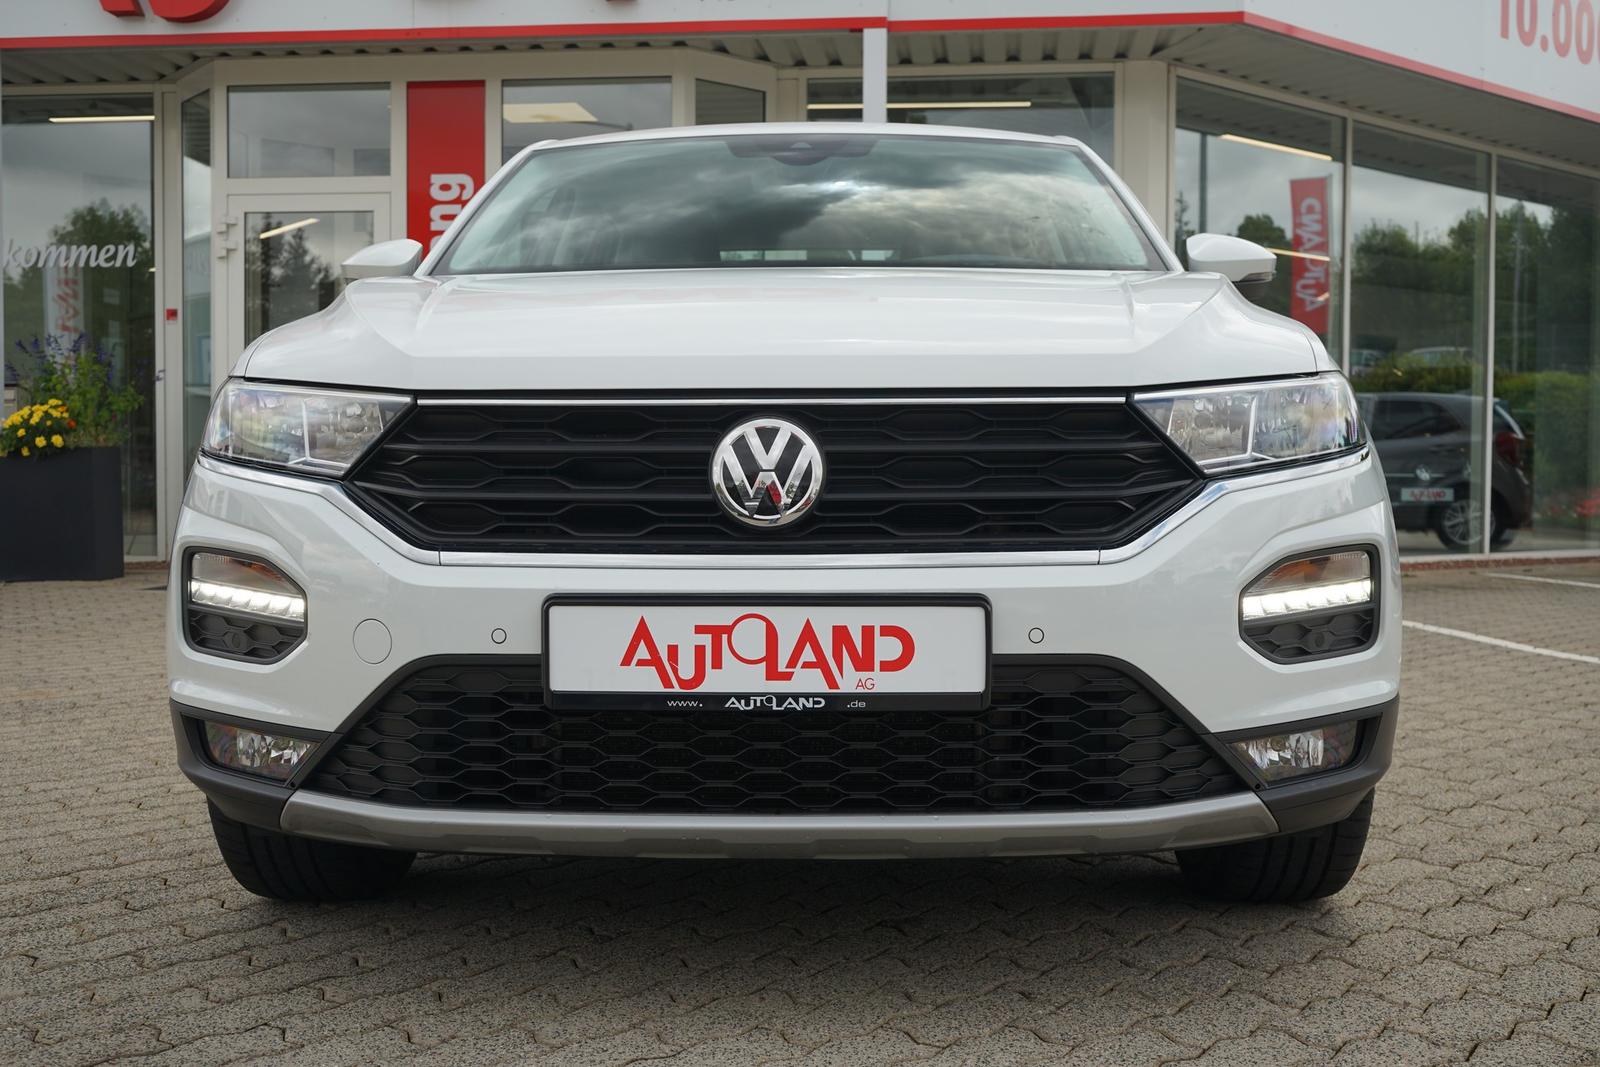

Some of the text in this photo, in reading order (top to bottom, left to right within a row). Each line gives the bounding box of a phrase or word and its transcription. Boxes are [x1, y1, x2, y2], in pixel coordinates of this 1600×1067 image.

[1500, 0, 1600, 66] 10.00
[429, 173, 475, 252] ng
[855, 677, 876, 690] AG
[667, 700, 703, 708] www.
[846, 699, 867, 709] .de
